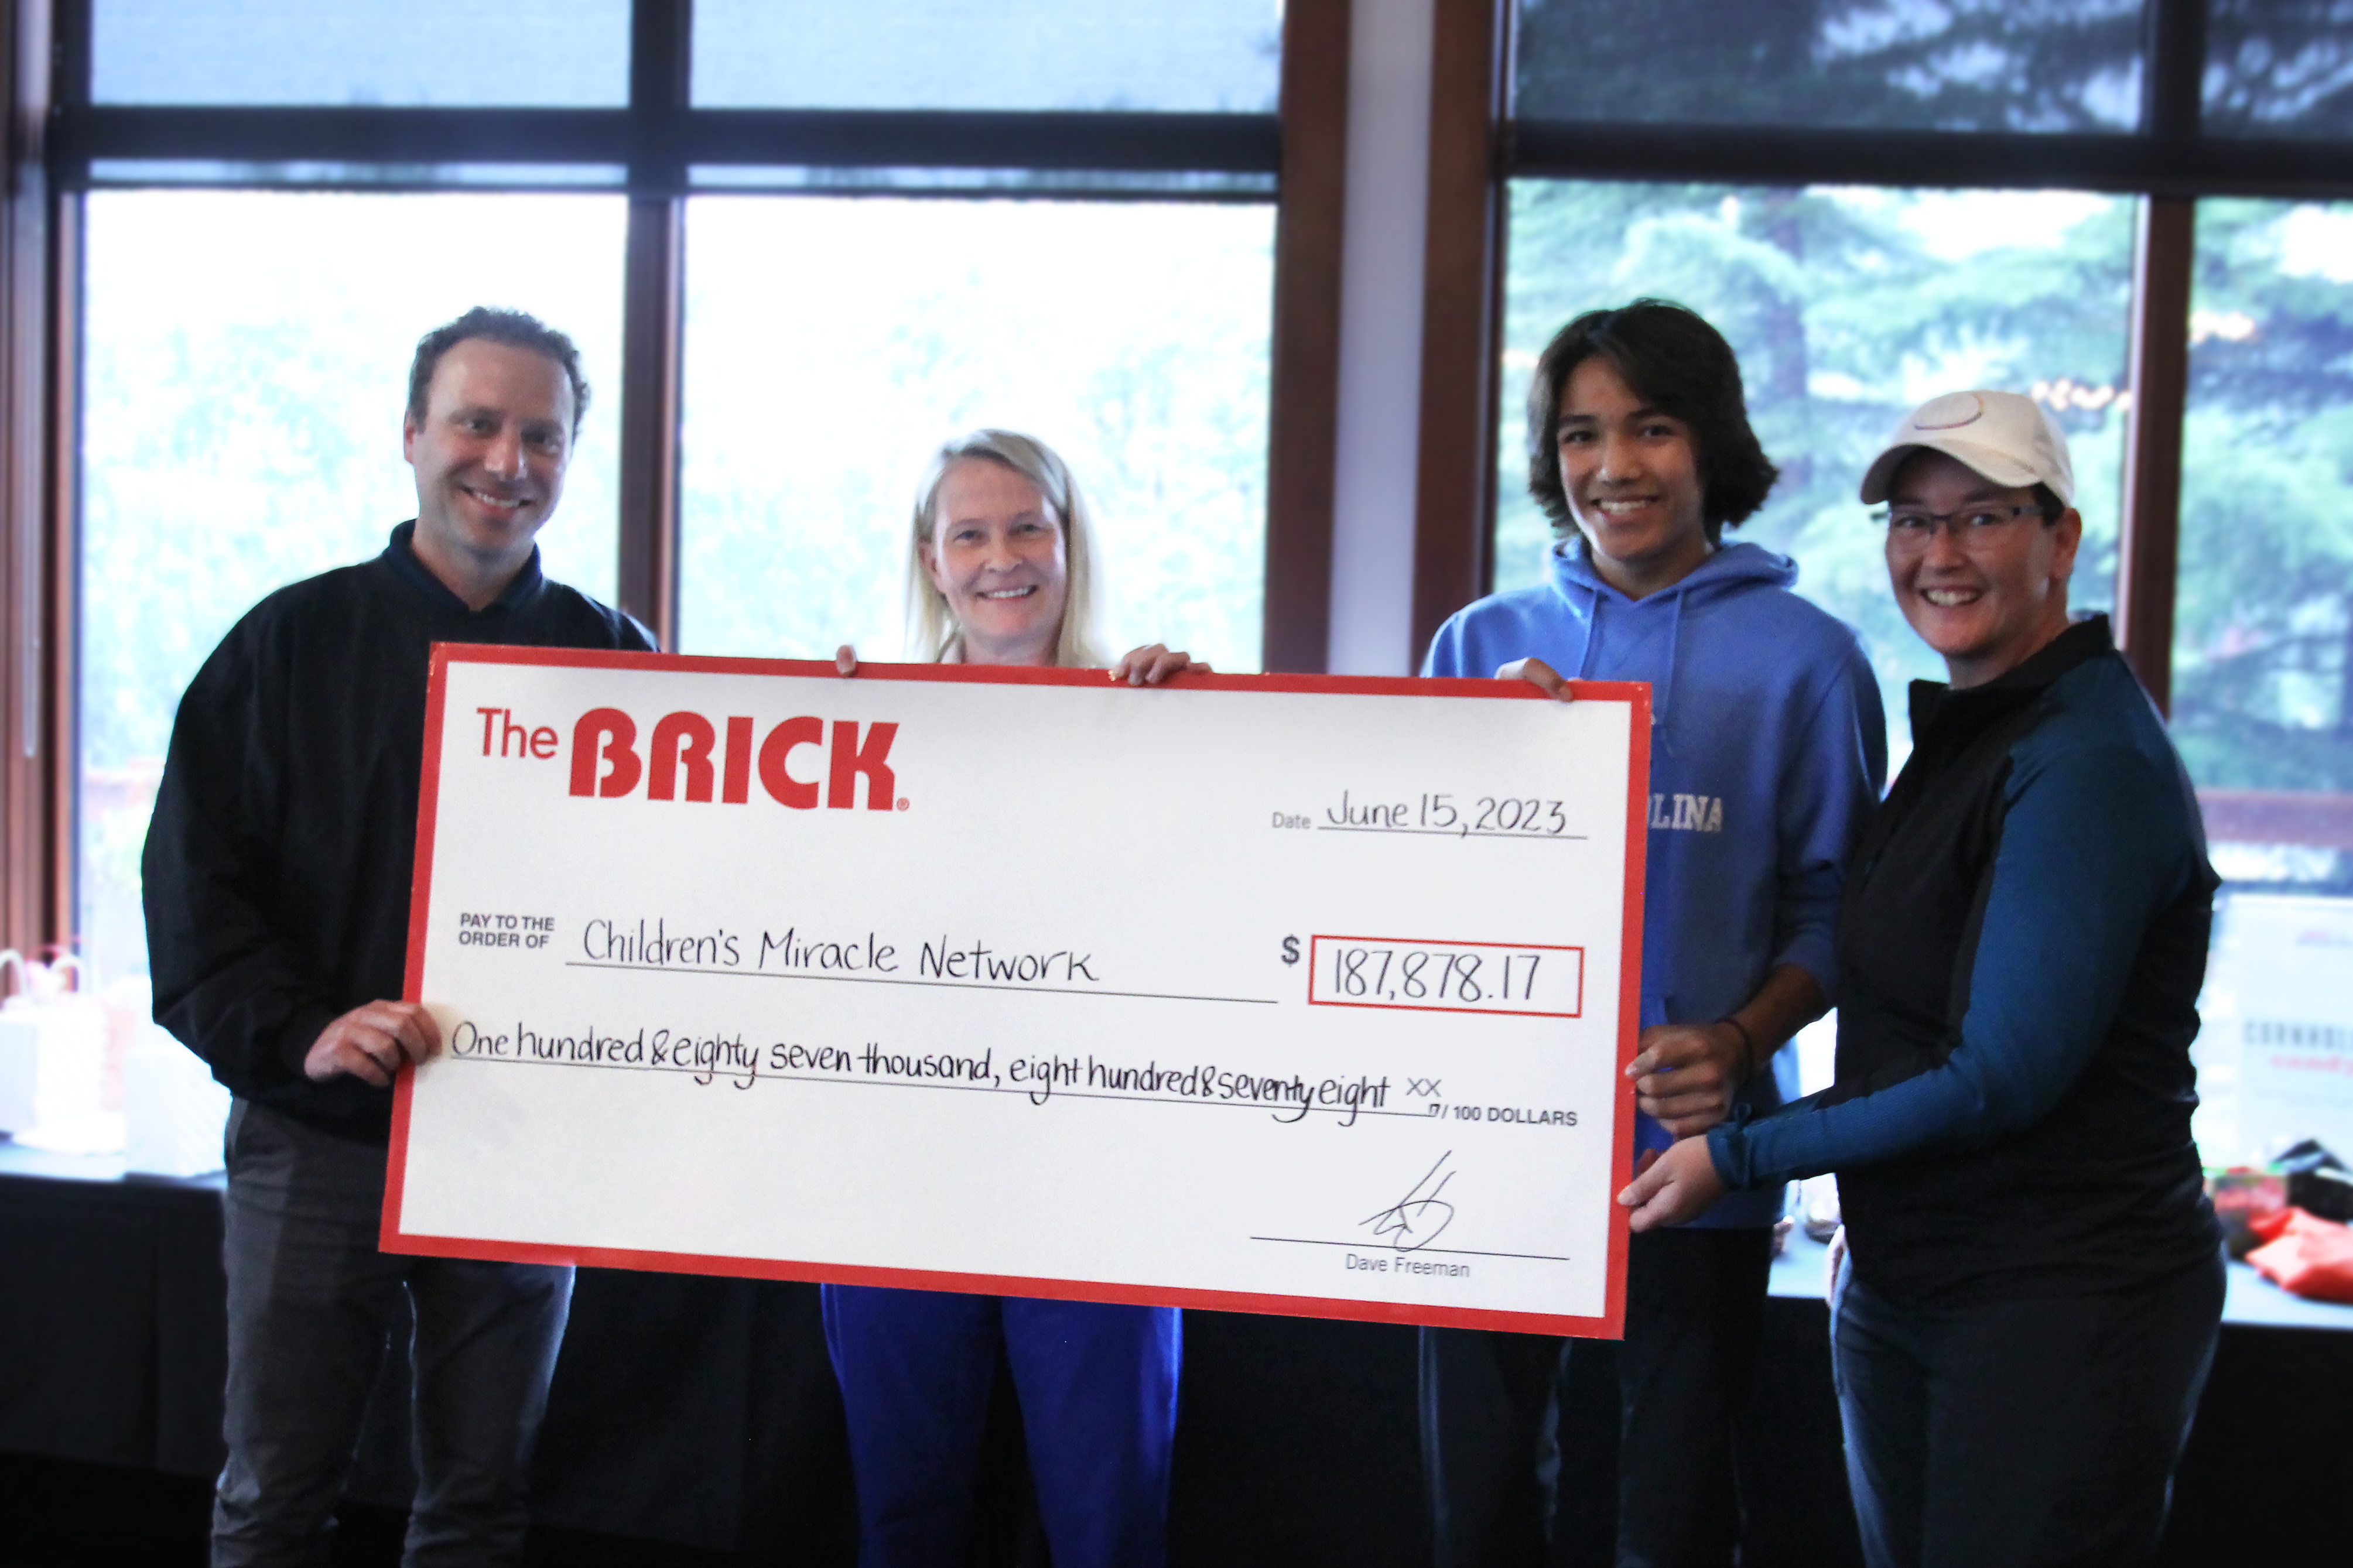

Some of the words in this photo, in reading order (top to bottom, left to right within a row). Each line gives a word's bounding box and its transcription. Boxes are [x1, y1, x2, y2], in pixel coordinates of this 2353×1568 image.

[477, 707, 559, 759] The
[1272, 812, 1311, 830] Date
[1326, 789, 1408, 827] June
[1475, 796, 1567, 836] 2023
[1647, 793, 1723, 832] LINA
[459, 930, 520, 947] ORDER
[525, 934, 550, 949] OF
[460, 912, 491, 929] PAY
[495, 915, 518, 929] TO
[521, 916, 555, 932] THE
[583, 917, 740, 966] Children's
[758, 927, 900, 972] Miracle
[919, 933, 1100, 981] Network
[1280, 934, 1301, 967] $
[1335, 948, 1541, 1004] 187,878.17
[452, 1021, 509, 1056] One
[517, 1022, 644, 1064] hundred
[673, 1031, 760, 1090] eighty
[770, 1042, 853, 1073] seven
[857, 1042, 1002, 1088] thousand,
[1009, 1055, 1084, 1105] eight
[1318, 1075, 1391, 1127] eight
[1487, 1106, 1578, 1127] DOLLARS
[1346, 1253, 1388, 1272] Dave
[1394, 1255, 1470, 1278] Freeman
